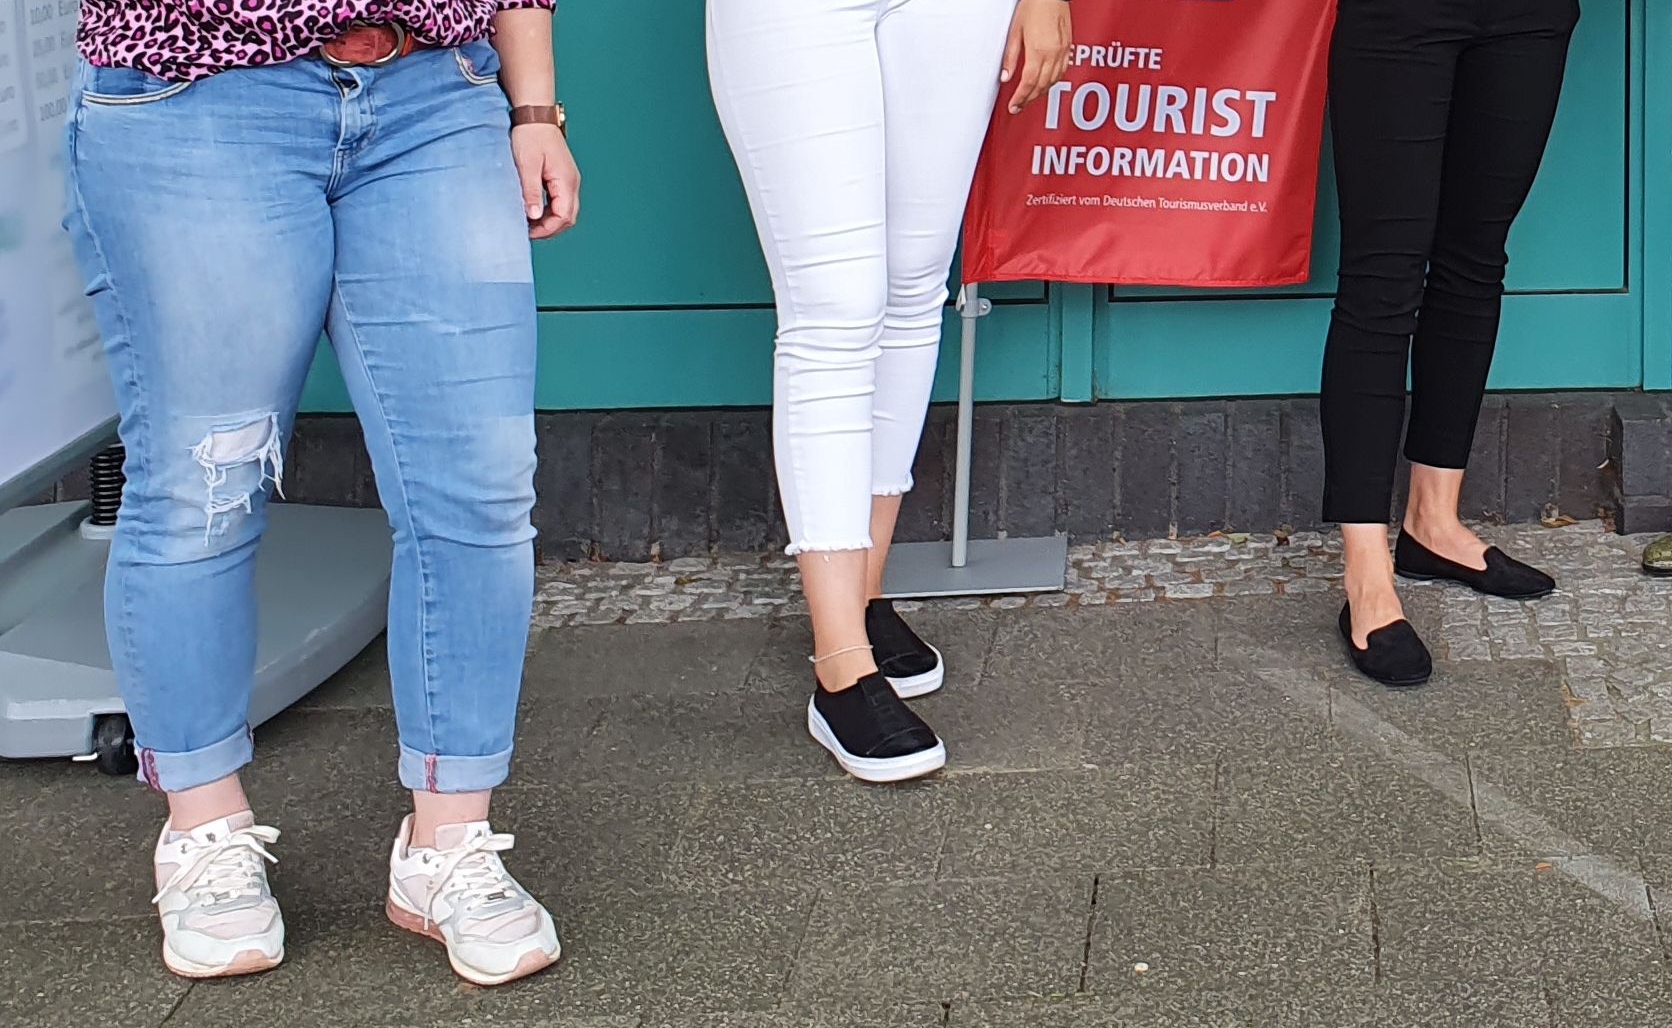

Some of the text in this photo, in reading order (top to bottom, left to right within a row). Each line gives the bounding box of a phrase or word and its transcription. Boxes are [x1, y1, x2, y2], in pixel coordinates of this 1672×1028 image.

[1068, 41, 1162, 70] PRÜFTE
[1045, 81, 1277, 138] TOURIST
[1031, 144, 1270, 183] INFORMATION
[1026, 194, 1268, 213] Zertifiziert vom Deutschen Tourismusverband e.V.
